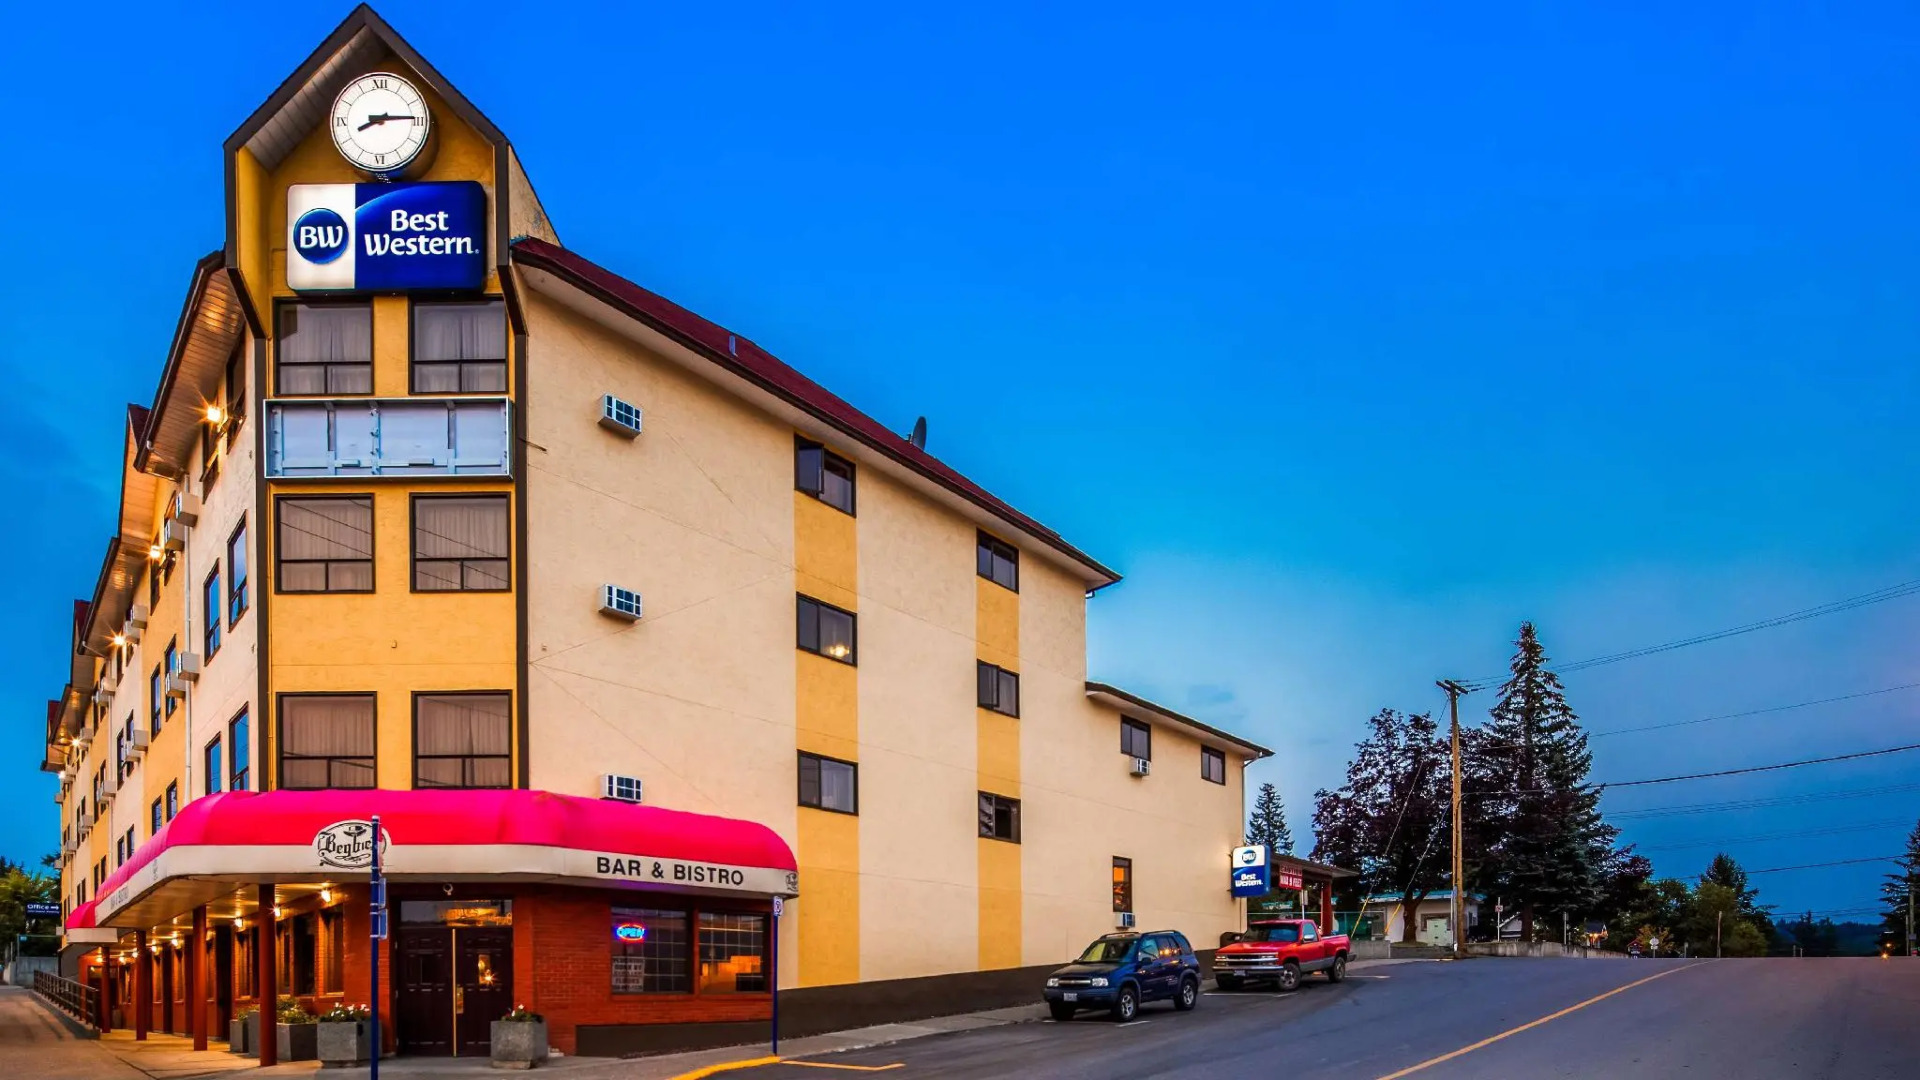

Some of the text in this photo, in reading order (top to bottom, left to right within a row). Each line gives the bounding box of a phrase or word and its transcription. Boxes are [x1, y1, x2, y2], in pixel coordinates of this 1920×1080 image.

[373, 79, 388, 89] XII
[336, 117, 347, 127] IX
[413, 117, 424, 127] III
[374, 155, 385, 165] VI
[391, 209, 449, 232] Best
[300, 225, 343, 249] BW
[596, 856, 744, 886] BAR & BISTRO
[27, 903, 50, 911] Office
[616, 927, 644, 938] OPEN
